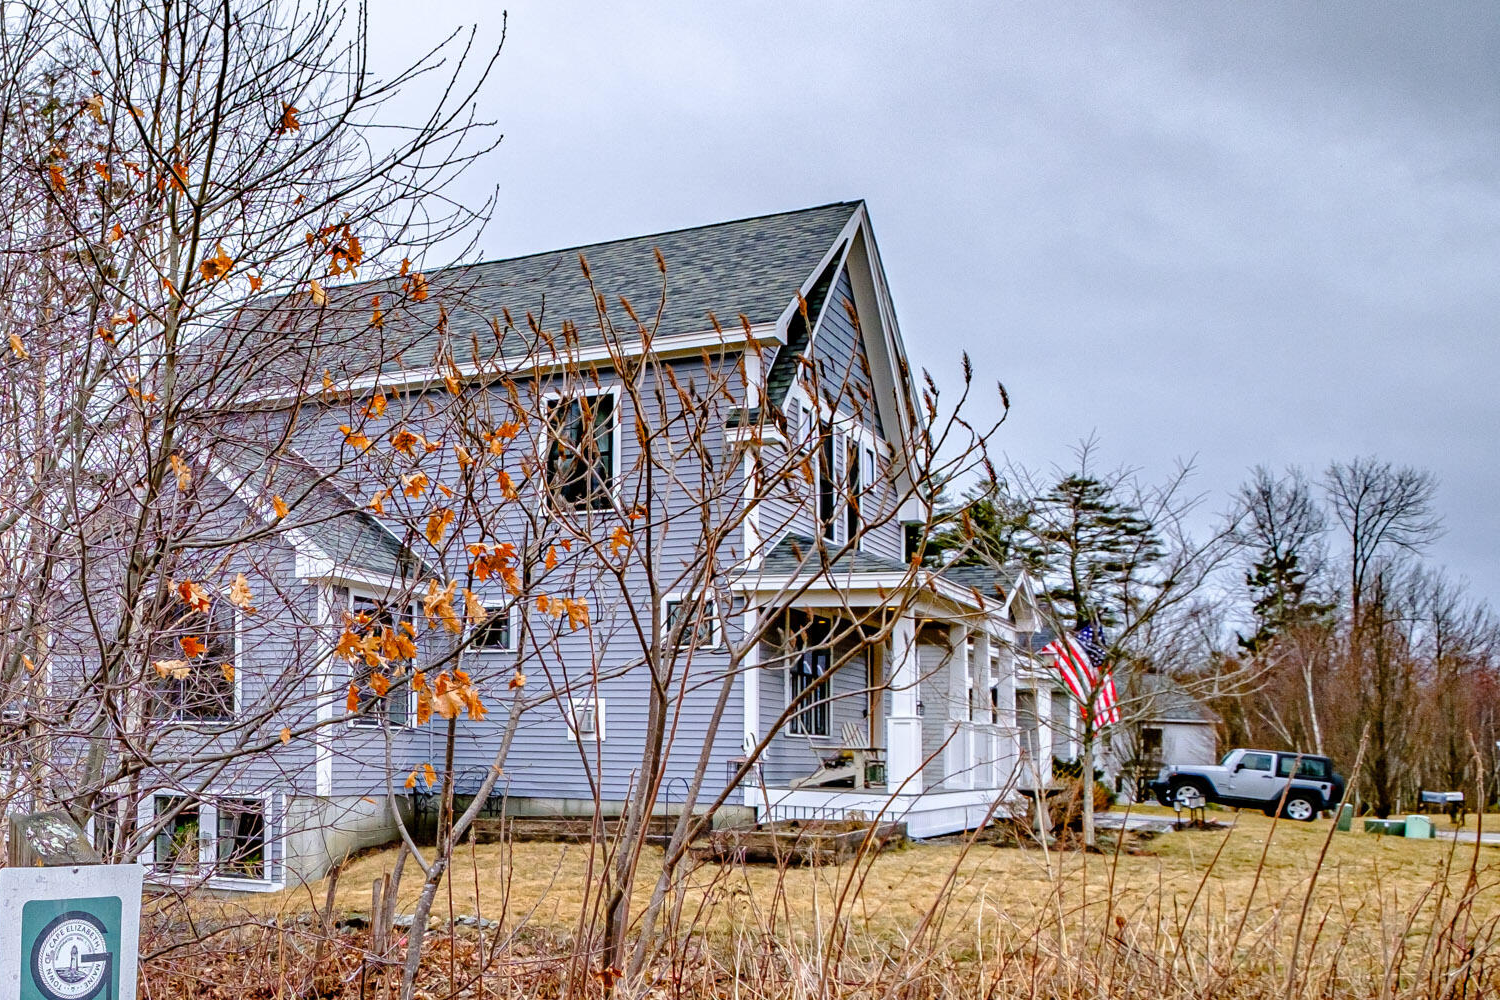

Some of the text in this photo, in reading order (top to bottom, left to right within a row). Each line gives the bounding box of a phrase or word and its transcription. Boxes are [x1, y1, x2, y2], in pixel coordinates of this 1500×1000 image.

[49, 930, 65, 949] CAPE
[44, 953, 52, 964] OF
[46, 968, 62, 991] TOWN
[85, 963, 101, 989] MAINE
